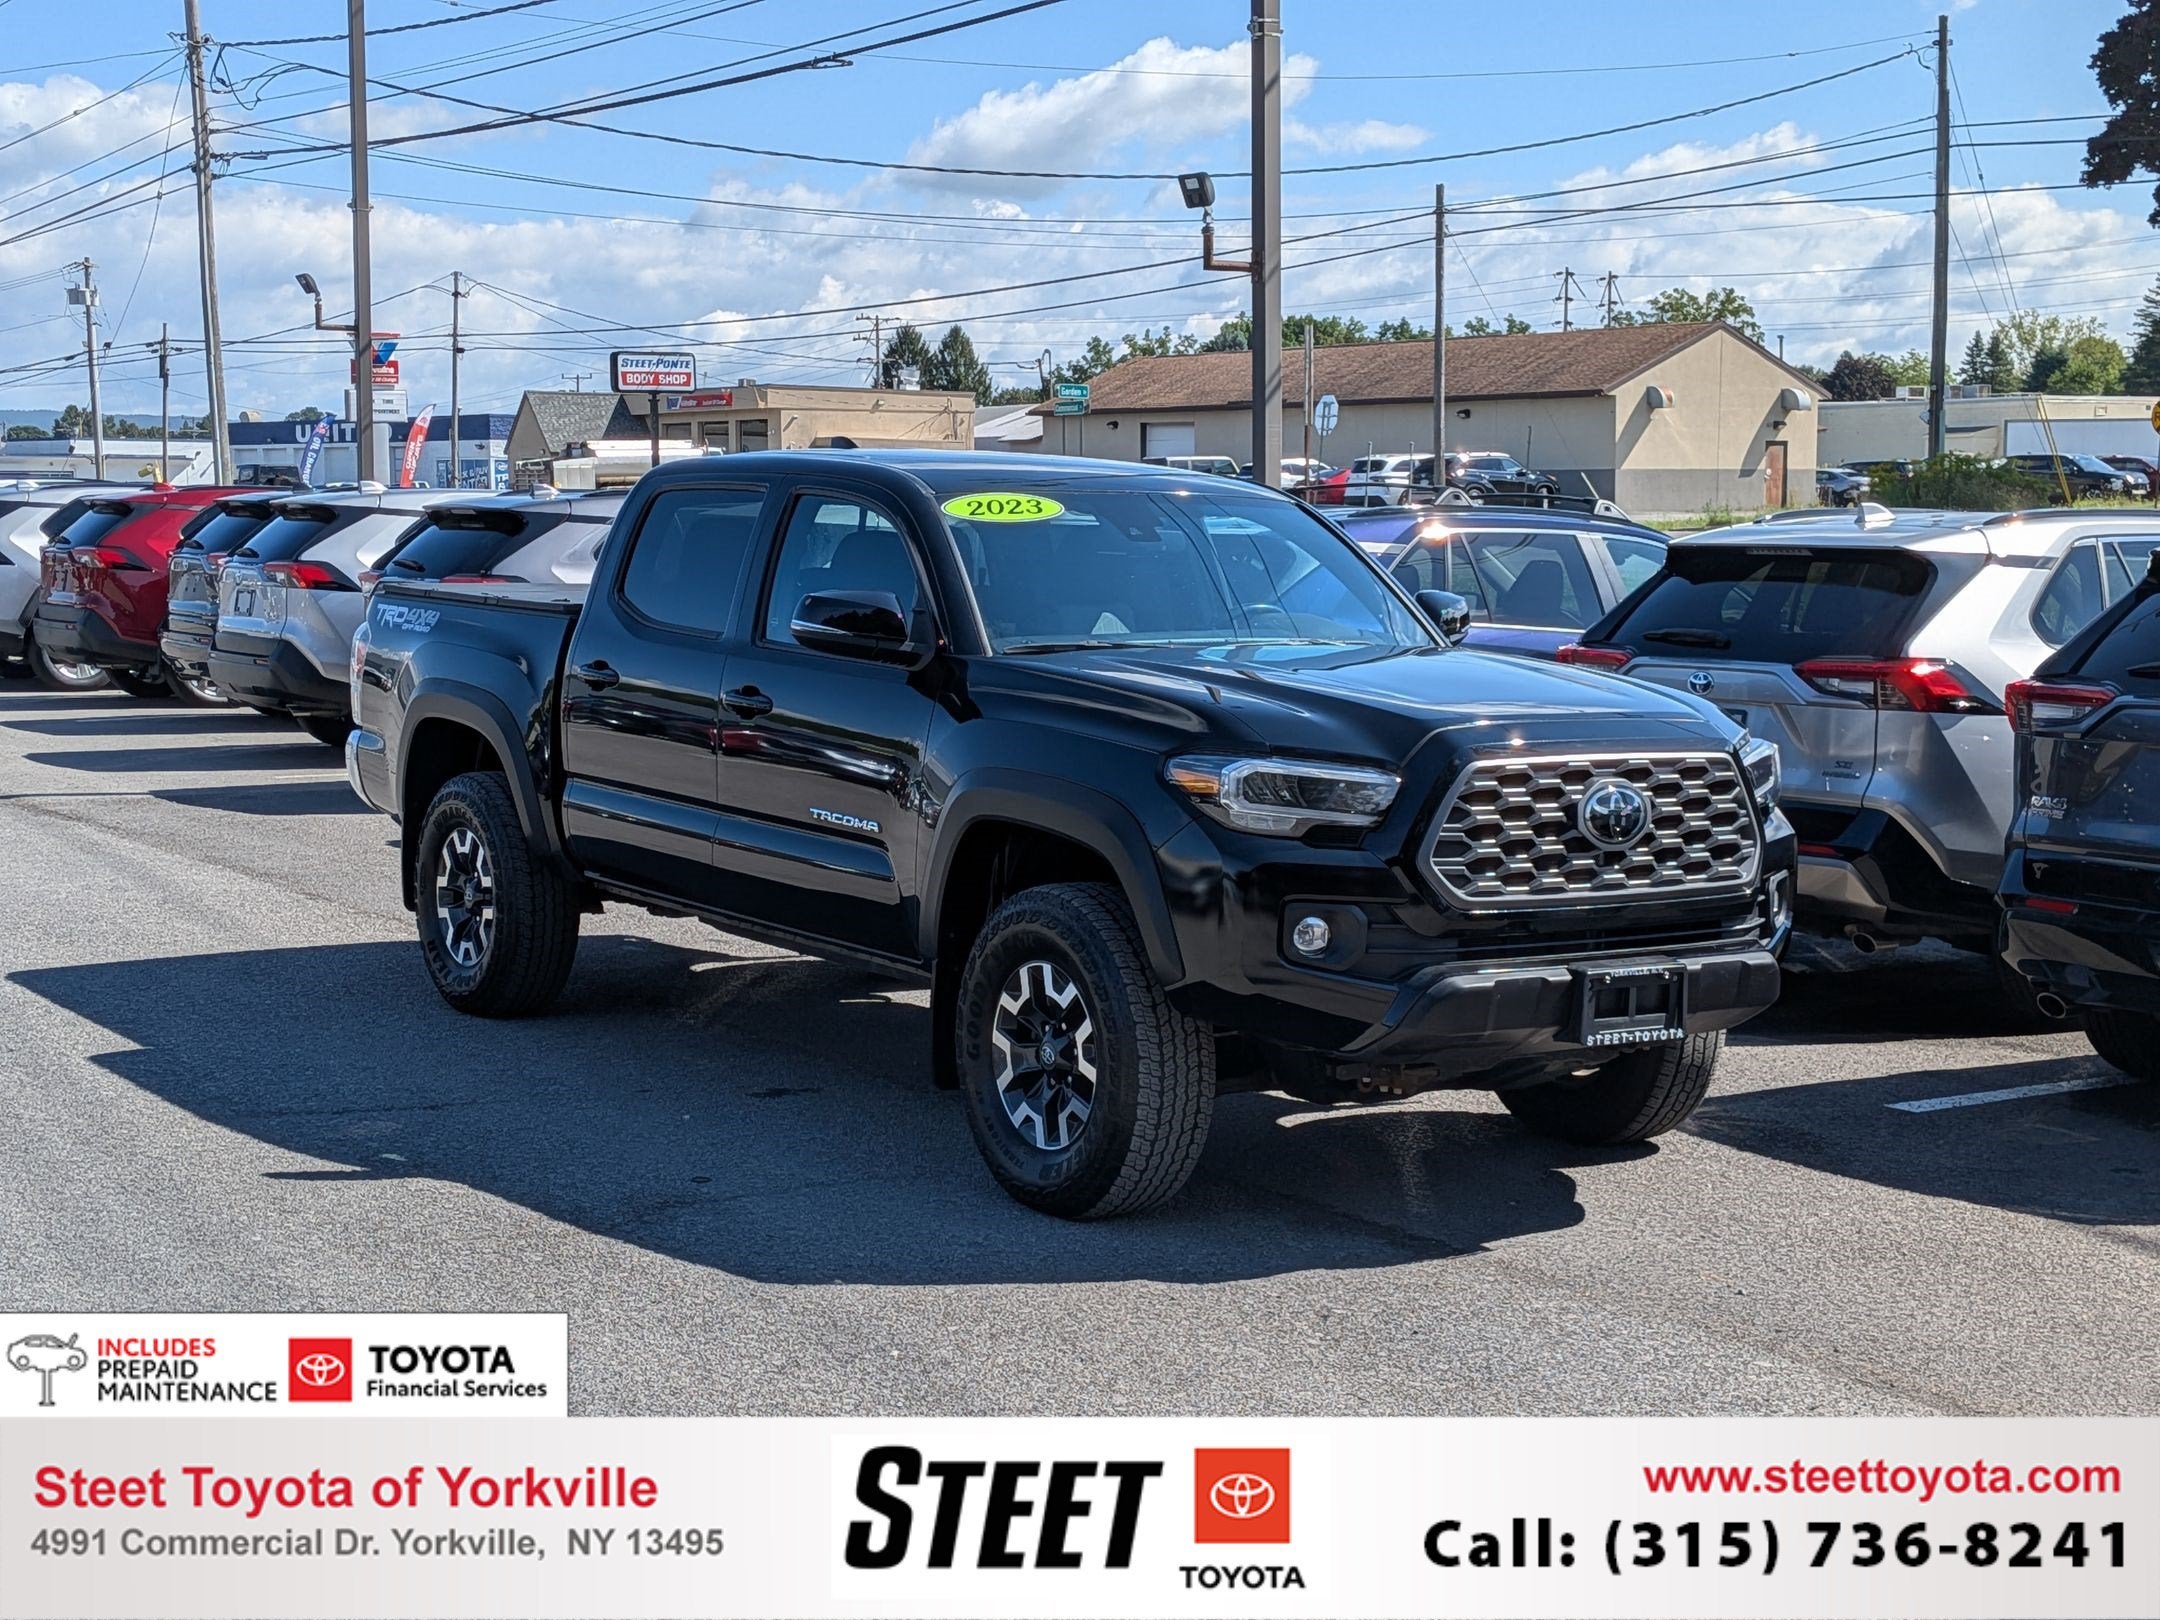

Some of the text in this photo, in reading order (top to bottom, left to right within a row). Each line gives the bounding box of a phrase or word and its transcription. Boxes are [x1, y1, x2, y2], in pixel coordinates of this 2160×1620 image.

[620, 357, 691, 369] STEET-PONTE
[626, 373, 688, 385] BODY SHOP
[966, 499, 1043, 516] 2023
[376, 603, 409, 629] TRD
[809, 807, 880, 833] TACOMA
